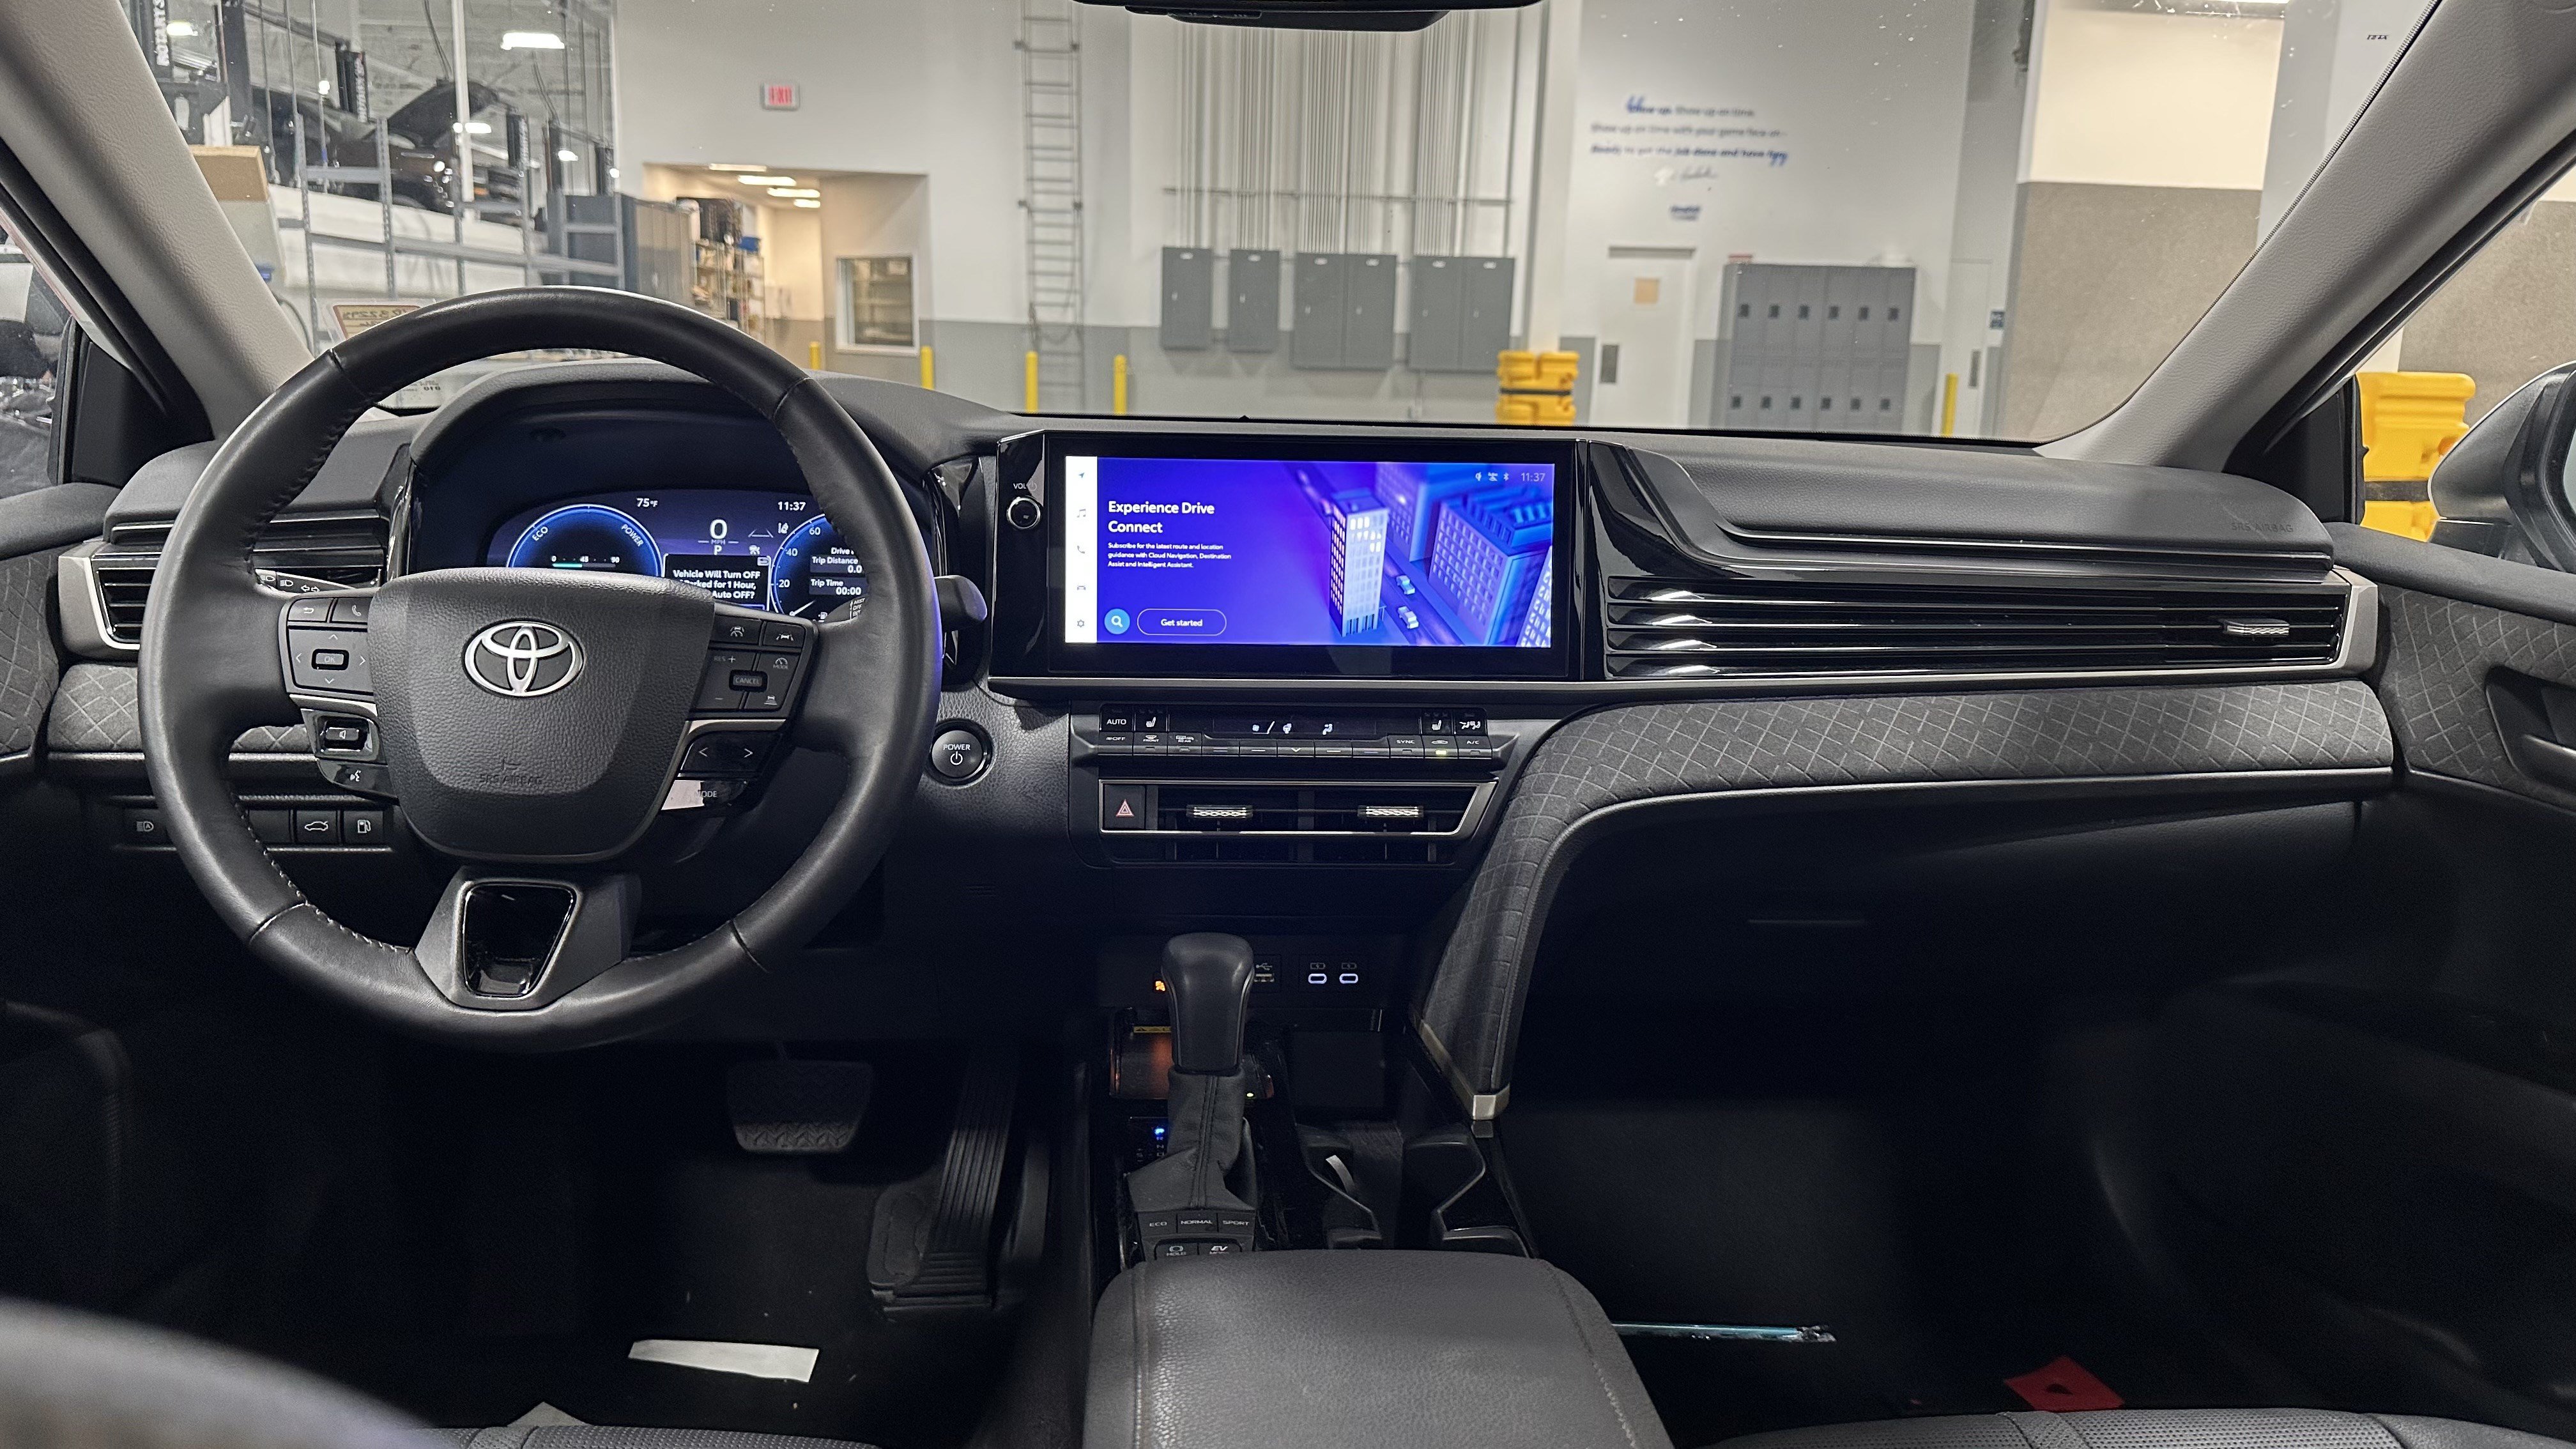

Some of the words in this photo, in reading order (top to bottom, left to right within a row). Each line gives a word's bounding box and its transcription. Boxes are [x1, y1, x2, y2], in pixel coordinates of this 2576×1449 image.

[1521, 472, 1546, 482] 11:37
[778, 502, 806, 511] 11:37
[1108, 500, 1179, 516] Experience
[1181, 502, 1215, 514] Drive
[710, 519, 728, 539] 0
[809, 526, 821, 535] 60
[1108, 521, 1163, 533] Connect
[532, 525, 549, 542] ECO
[620, 524, 644, 547] POWER
[714, 544, 722, 555] P
[786, 548, 798, 556] 40
[831, 547, 850, 555] Drive
[812, 556, 826, 565] Trip
[827, 556, 859, 565] Distance
[847, 565, 862, 573] 0.0
[673, 570, 703, 578] Vehicle
[704, 570, 721, 578] Will
[723, 571, 741, 579] Turn
[733, 581, 756, 590] Hour,
[778, 579, 790, 588] 20
[811, 578, 825, 588] Trip
[836, 586, 862, 595] 00:00
[1160, 618, 1176, 627] Get
